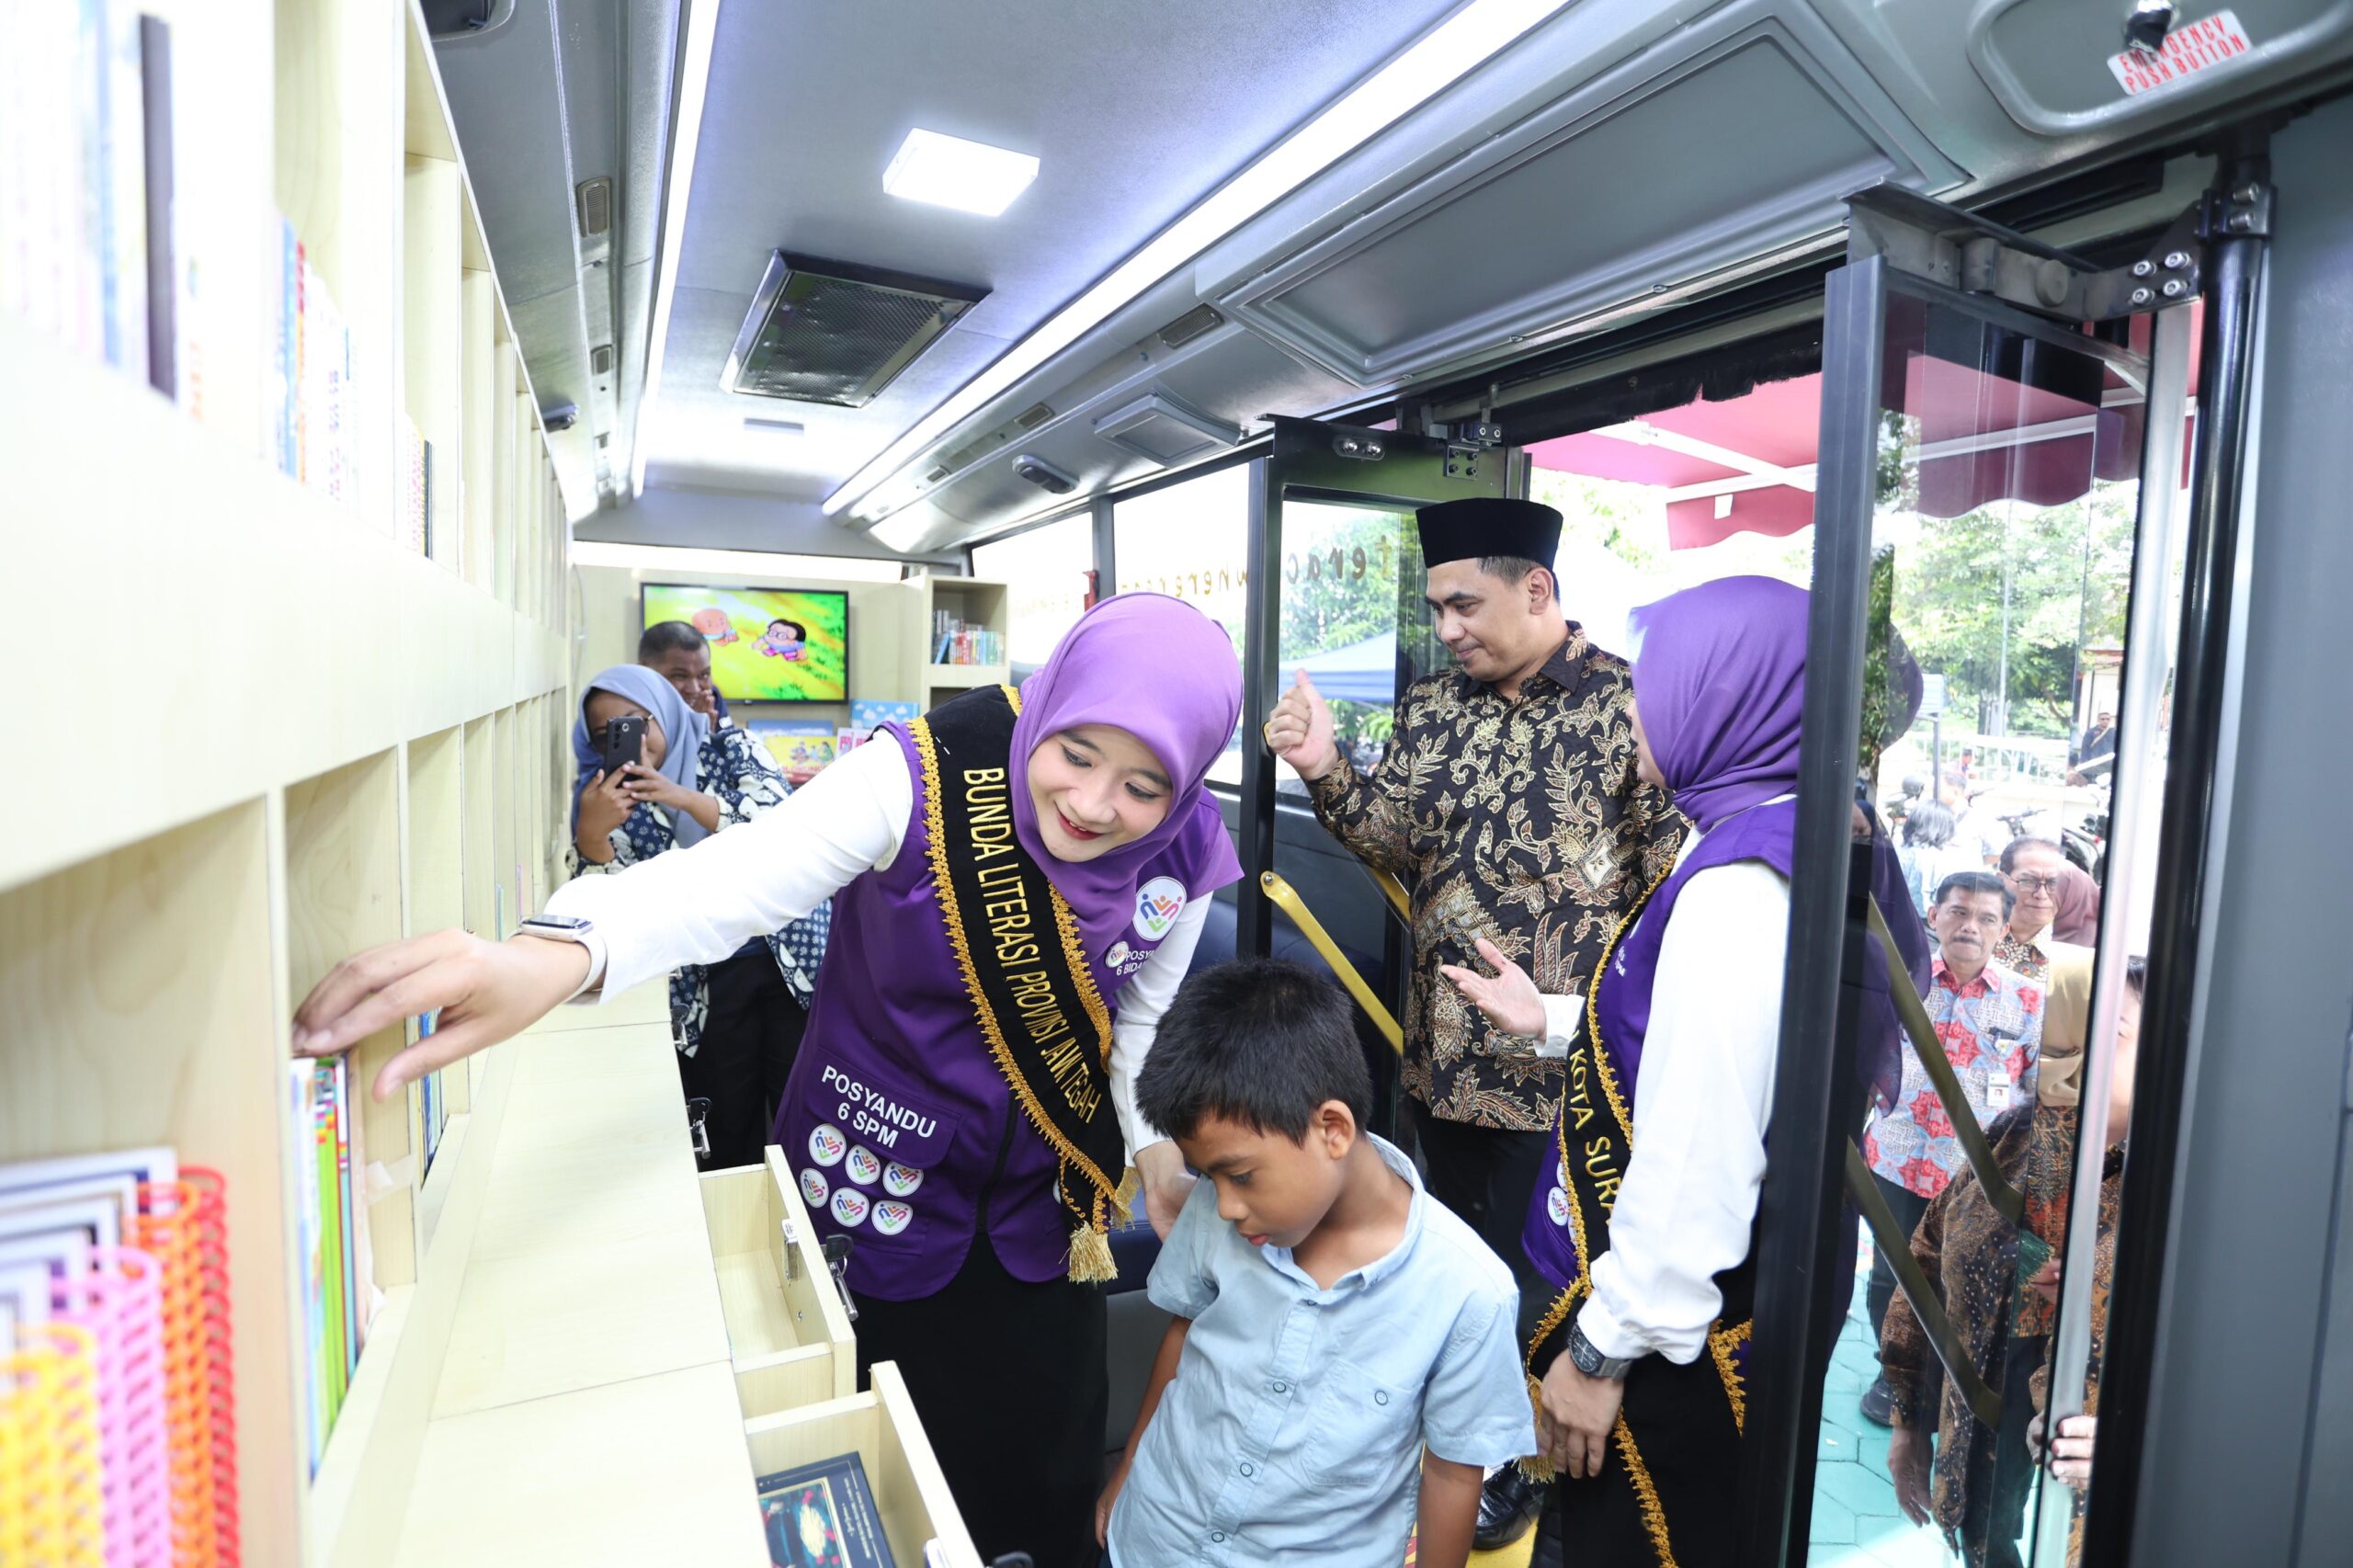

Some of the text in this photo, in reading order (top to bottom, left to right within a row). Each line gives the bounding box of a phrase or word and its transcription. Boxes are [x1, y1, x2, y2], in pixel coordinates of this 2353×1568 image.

[2124, 33, 2245, 93] PUSH BUTTON
[963, 767, 1015, 861] BUNDA
[977, 863, 1040, 968] LITERASI
[1116, 965, 1123, 976] 6
[1125, 949, 1154, 962] POSY
[822, 1064, 937, 1138] POSYANDU
[1569, 1048, 1595, 1131] KOTA
[837, 1102, 899, 1149] 6 SPM
